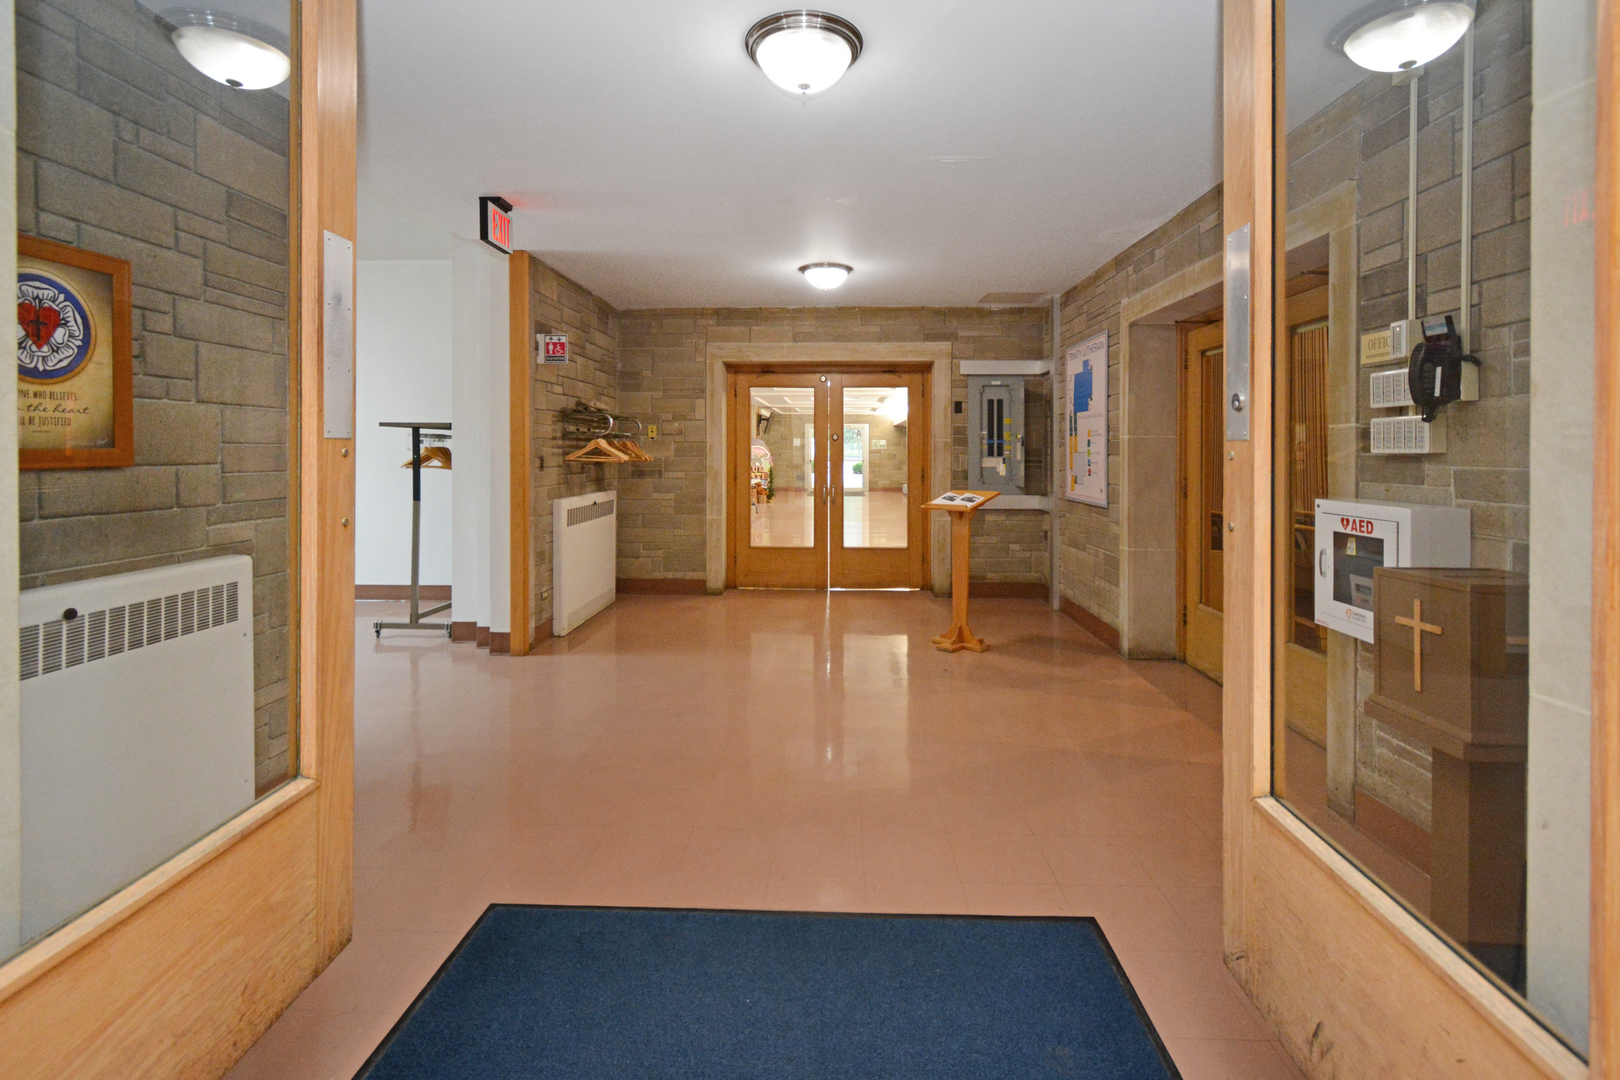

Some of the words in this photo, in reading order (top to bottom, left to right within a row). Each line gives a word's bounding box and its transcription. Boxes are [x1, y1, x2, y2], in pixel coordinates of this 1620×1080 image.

[492, 208, 510, 248] EXIT
[33, 390, 47, 400] WHO
[49, 390, 77, 402] BELIEVES
[26, 402, 51, 413] the
[53, 403, 90, 415] heart
[28, 416, 36, 426] BE
[38, 416, 72, 427] JUSTIFIED
[1350, 518, 1374, 535] AED
